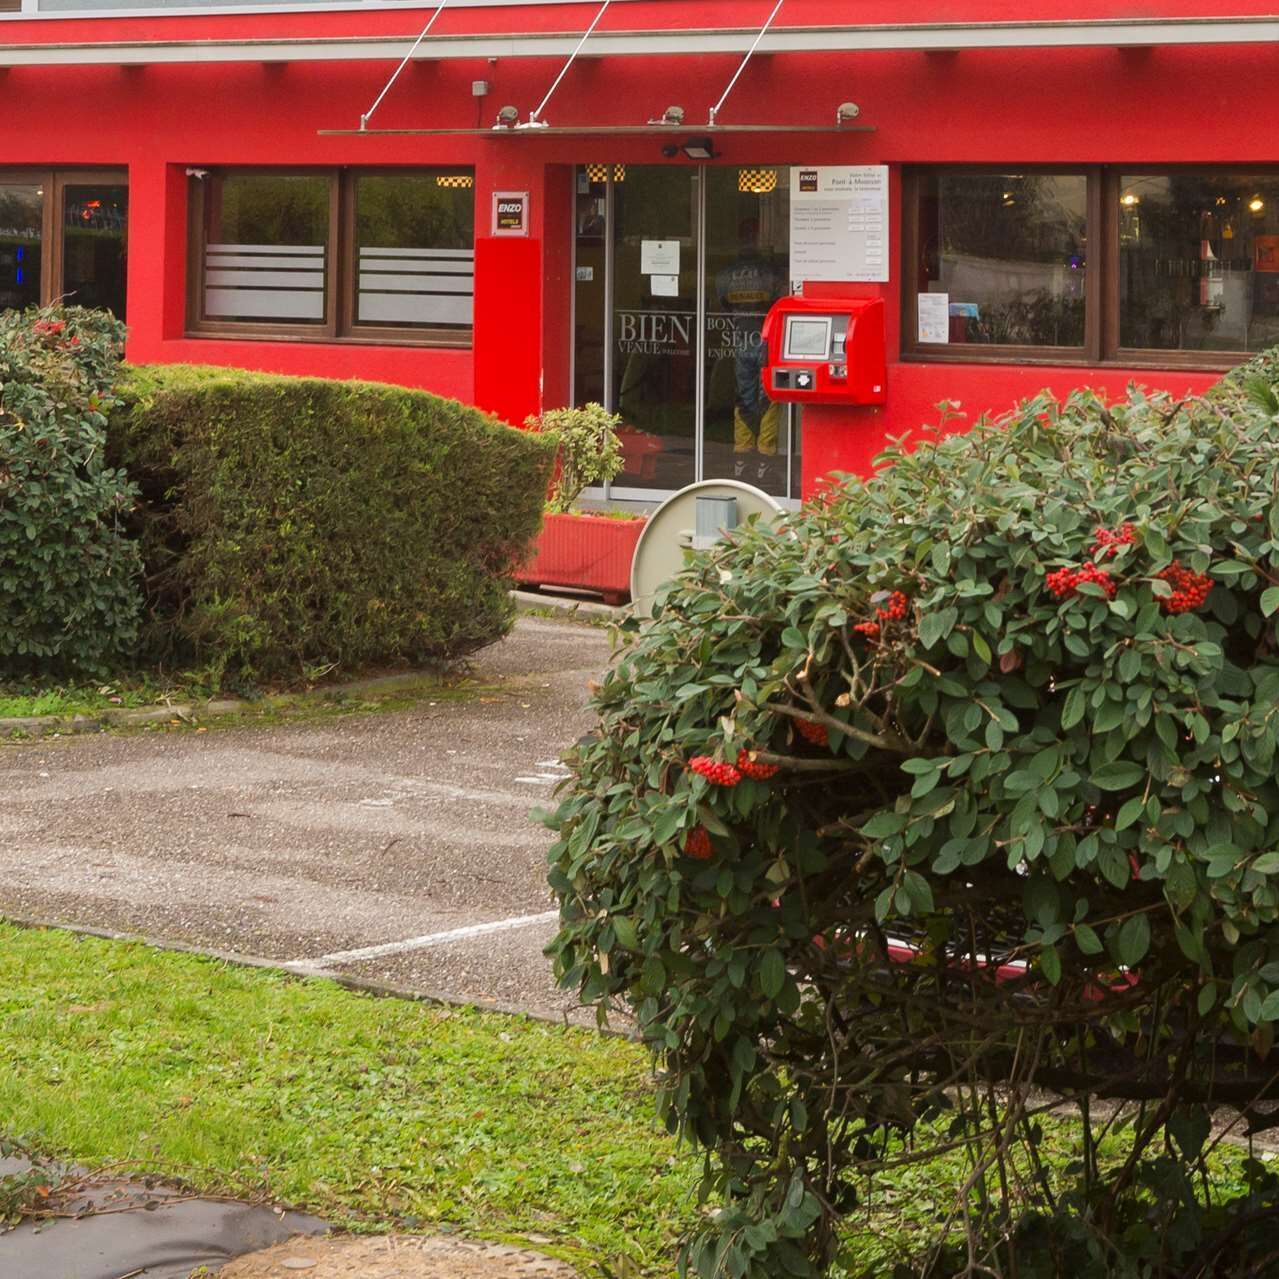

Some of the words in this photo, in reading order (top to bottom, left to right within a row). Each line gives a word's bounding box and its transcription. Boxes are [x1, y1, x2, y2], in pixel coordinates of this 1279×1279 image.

[498, 203, 522, 213] ENZO
[619, 314, 692, 344] BIEN
[707, 318, 737, 330] BON
[721, 326, 763, 352] SÉJO
[618, 342, 661, 355] VENUE
